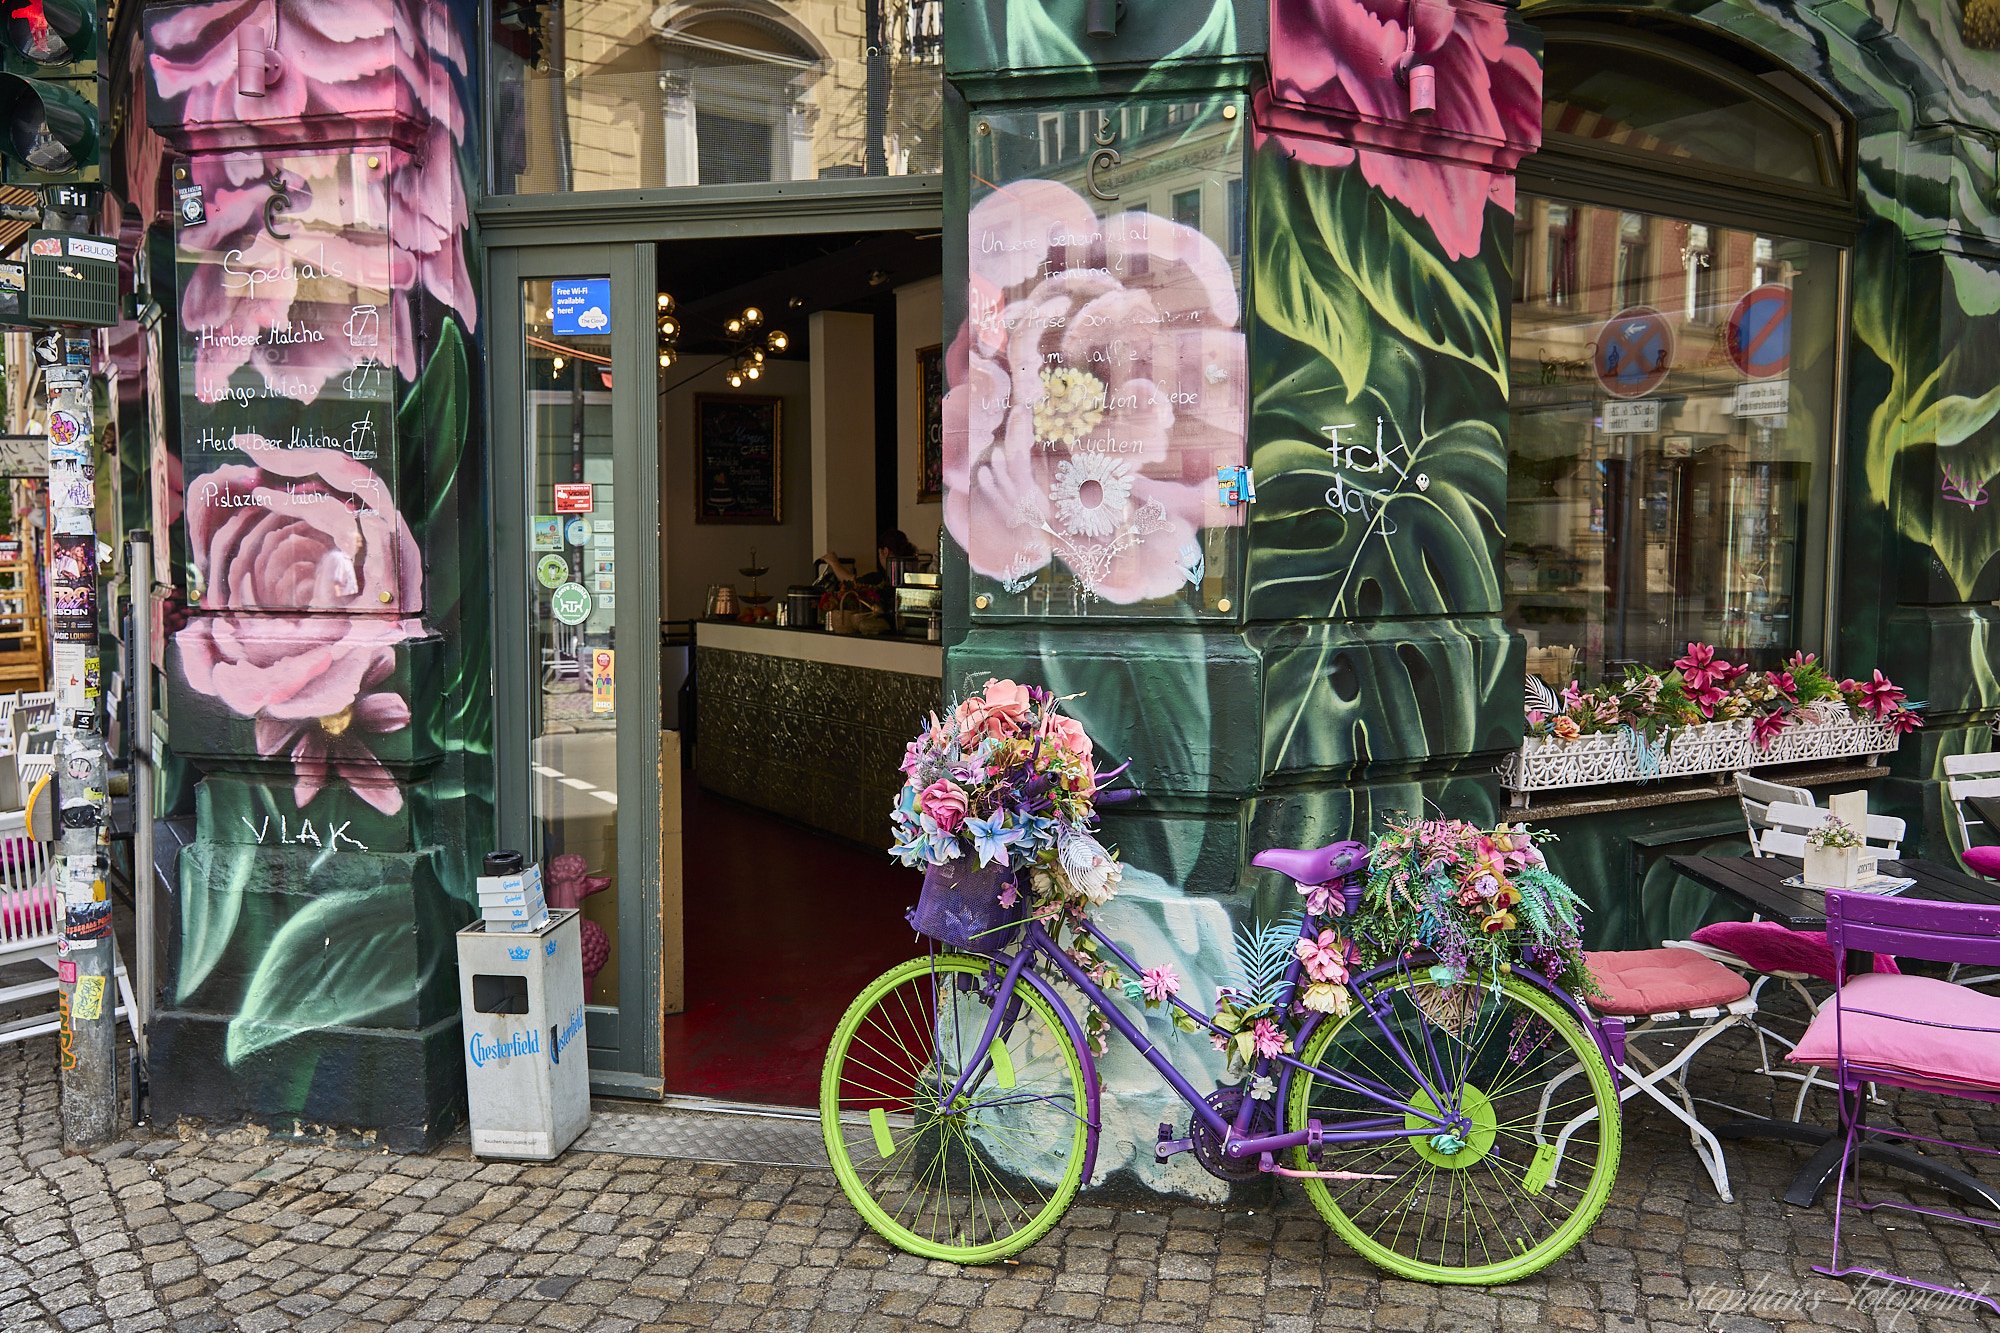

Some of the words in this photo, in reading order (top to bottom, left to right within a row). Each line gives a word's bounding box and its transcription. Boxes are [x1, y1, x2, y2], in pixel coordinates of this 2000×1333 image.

[60, 190, 87, 207] F11
[221, 242, 344, 300] Specials
[556, 288, 571, 296] Free
[571, 286, 588, 295] Wi-Fi
[556, 297, 585, 305] available
[557, 306, 574, 314] here!
[201, 323, 263, 349] Himbeer
[268, 318, 325, 346] Matcha
[200, 376, 257, 408] Mango
[287, 425, 342, 449] Matcha
[241, 814, 369, 854] VLAK
[469, 1029, 540, 1068] Chesterfield
